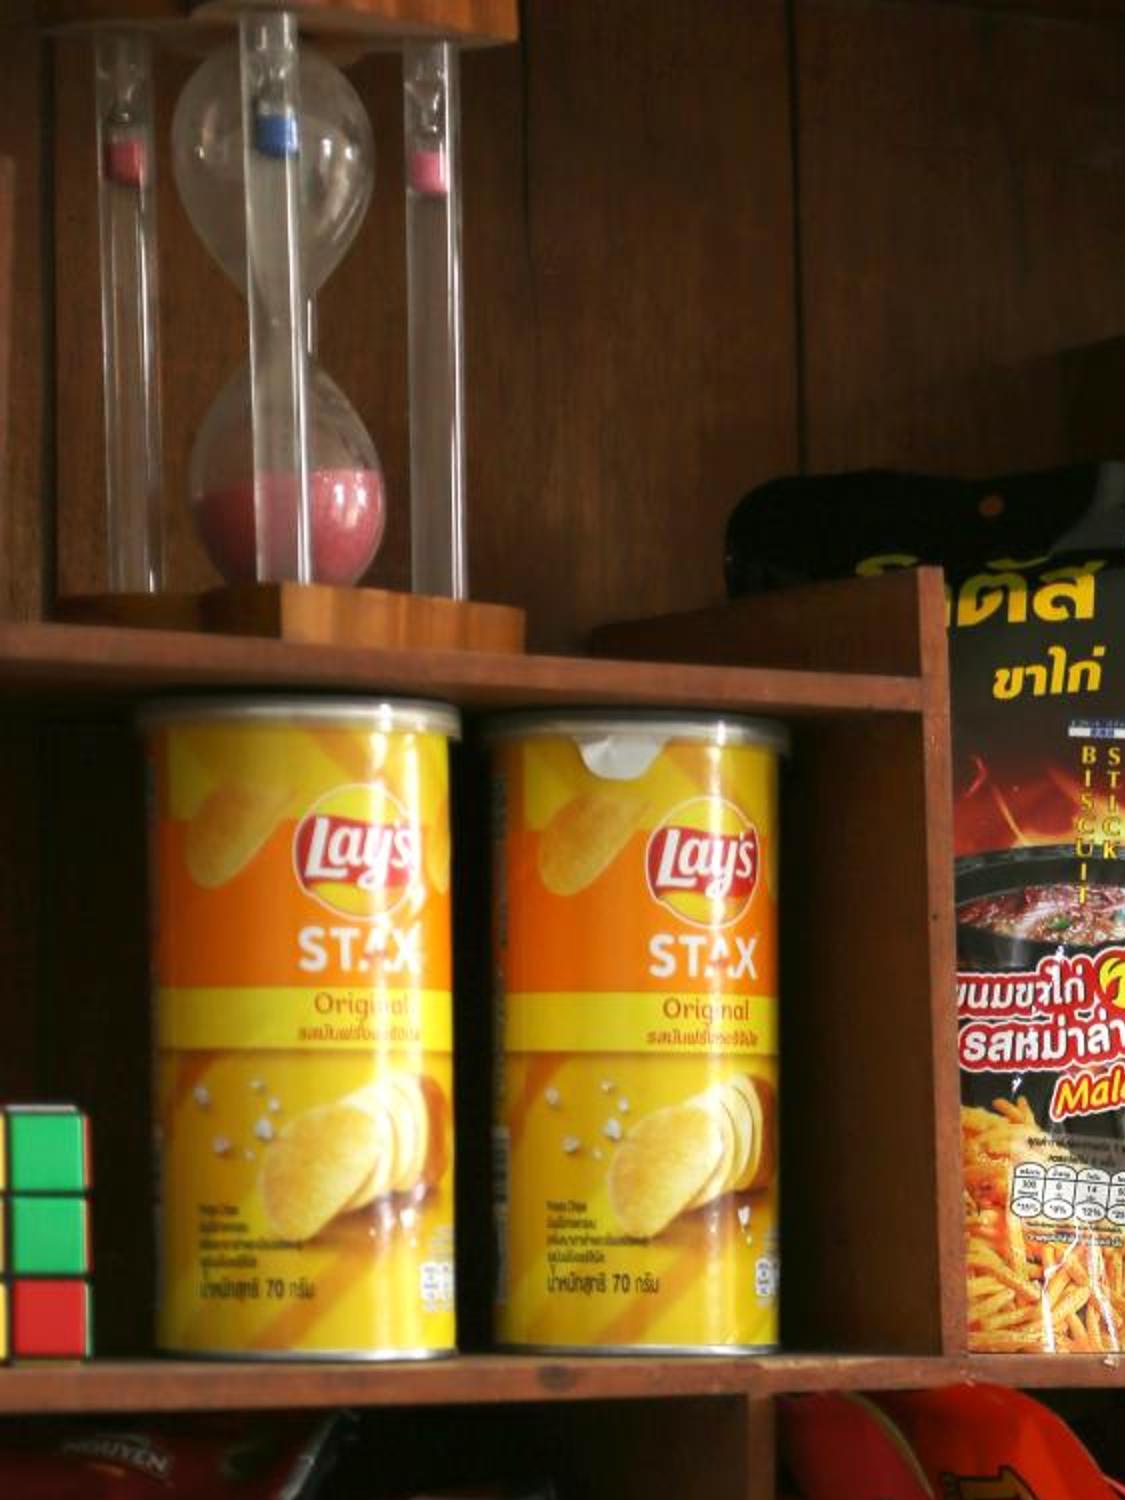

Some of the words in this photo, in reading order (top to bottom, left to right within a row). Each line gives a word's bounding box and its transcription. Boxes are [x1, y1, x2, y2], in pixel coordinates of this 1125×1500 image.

[992, 645, 1106, 700] ขาไก่
[1075, 745, 1097, 905] BISCUIT
[1102, 747, 1121, 860] STICK
[304, 816, 415, 890] Lay's
[655, 828, 754, 898] Lay's
[298, 925, 420, 974] STAX
[649, 933, 759, 980] STAX
[266, 1279, 284, 1298] 70
[612, 1274, 631, 1294] 70
